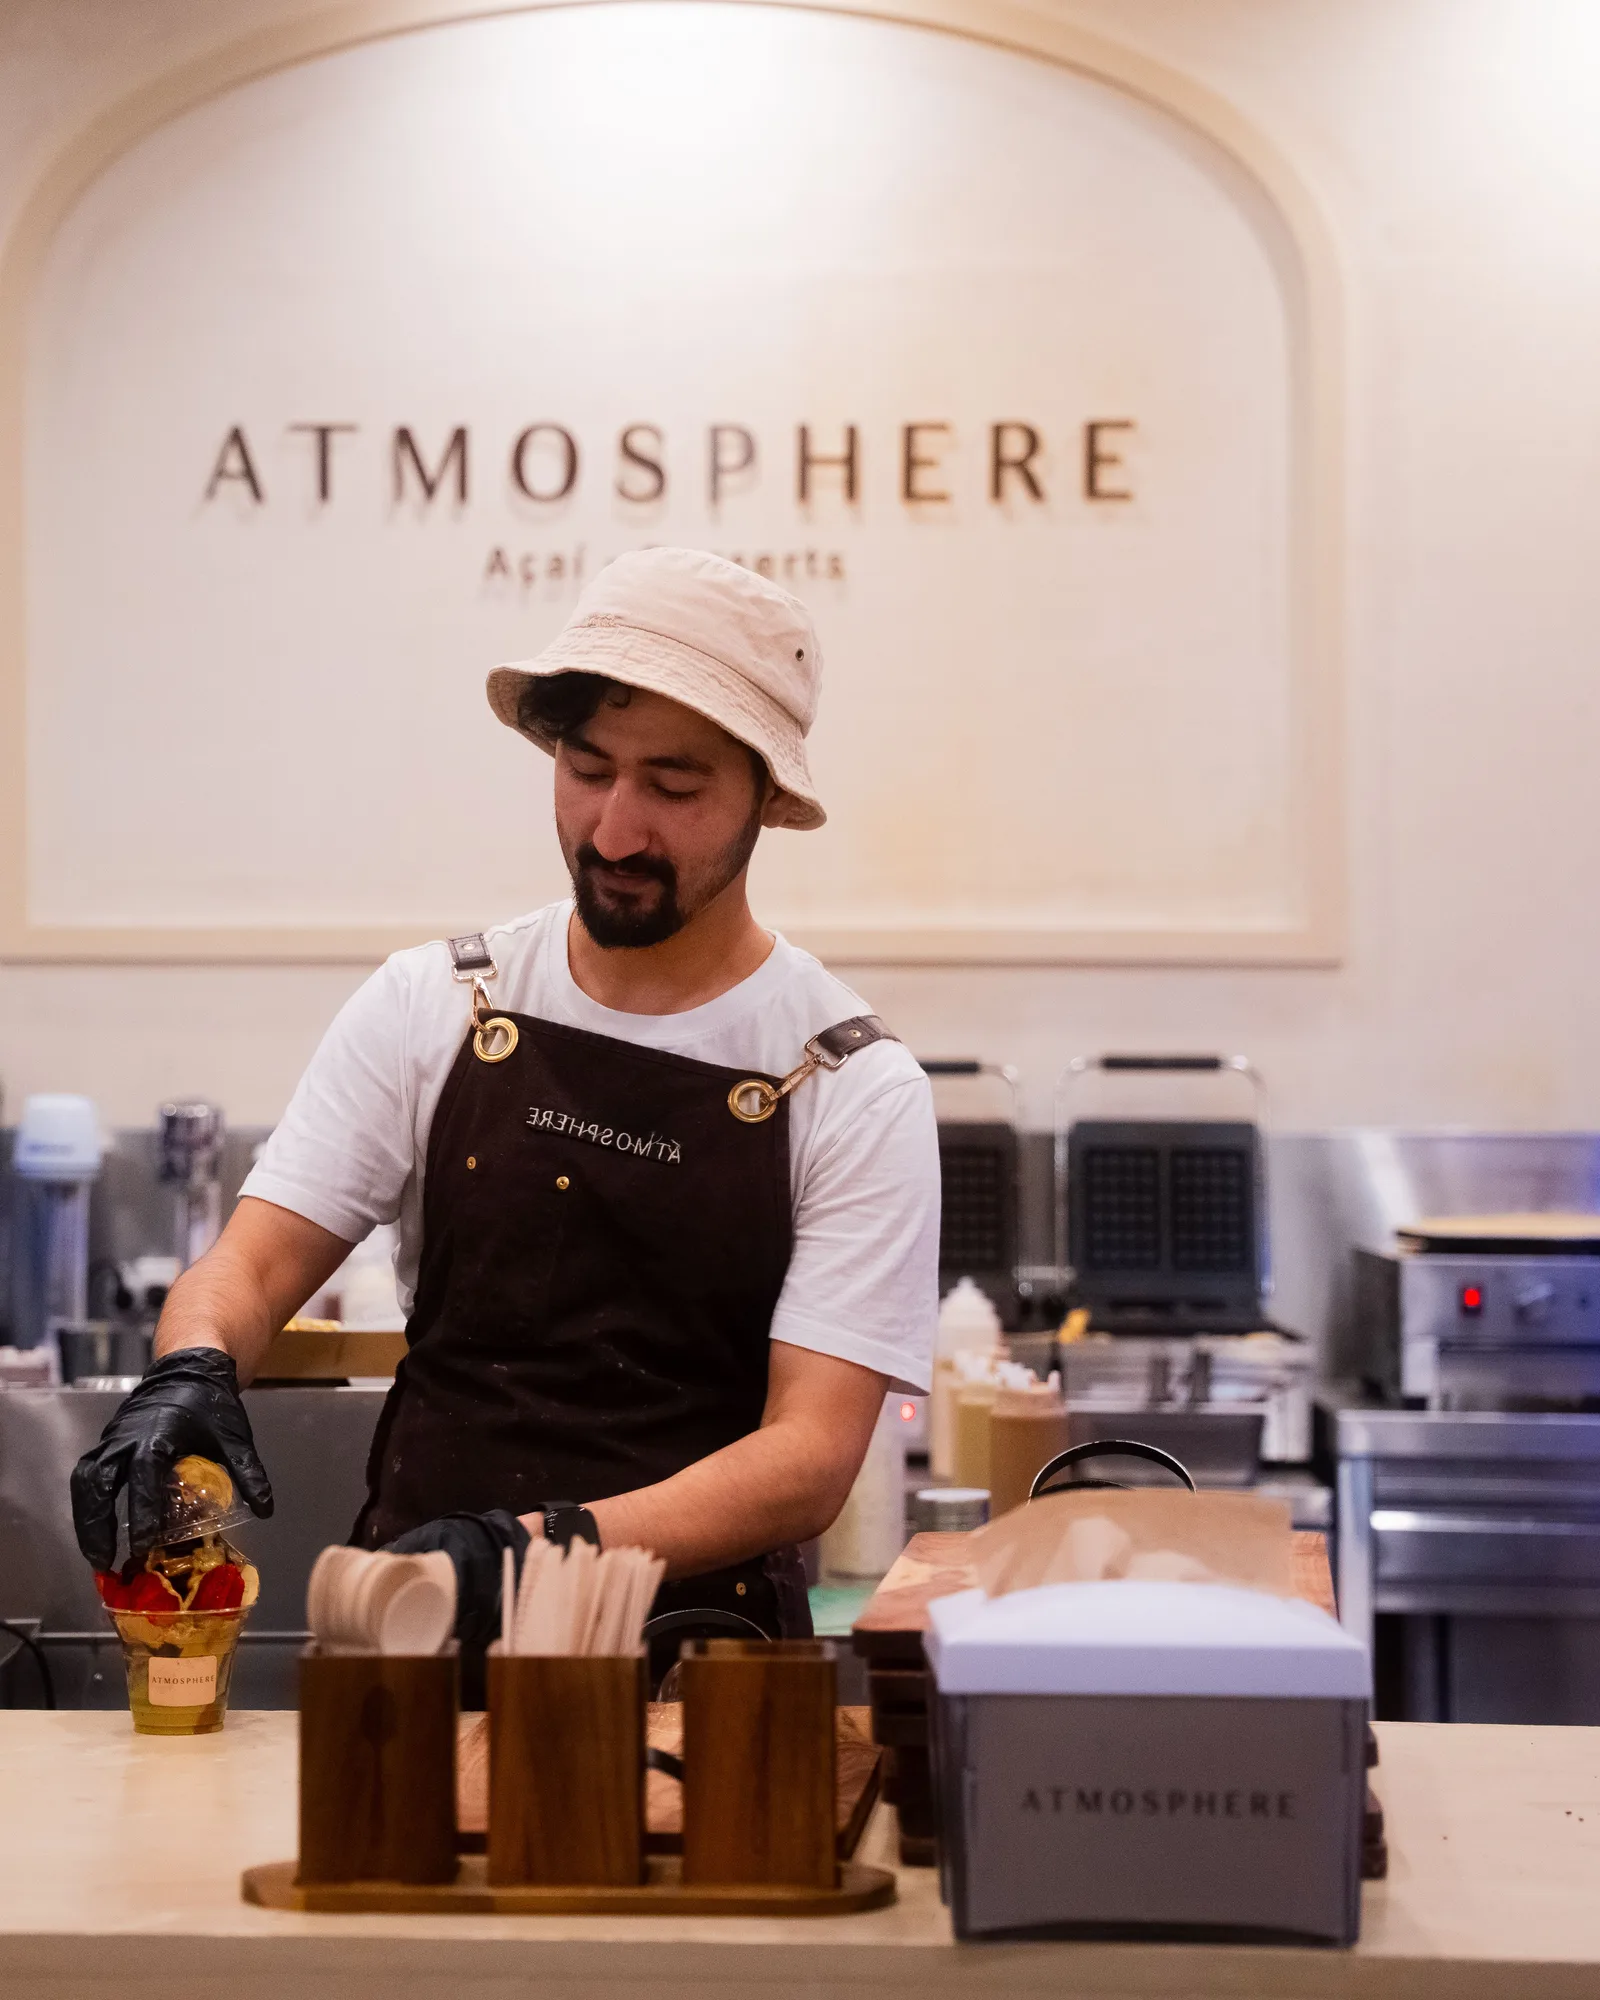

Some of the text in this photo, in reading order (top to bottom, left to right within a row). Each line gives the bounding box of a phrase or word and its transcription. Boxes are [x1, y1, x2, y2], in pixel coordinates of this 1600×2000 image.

[205, 420, 1135, 505] ATMOSPHERE
[152, 1675, 215, 1685] ATMOSPHERE
[1020, 1787, 1296, 1819] ATMOSPHERE
